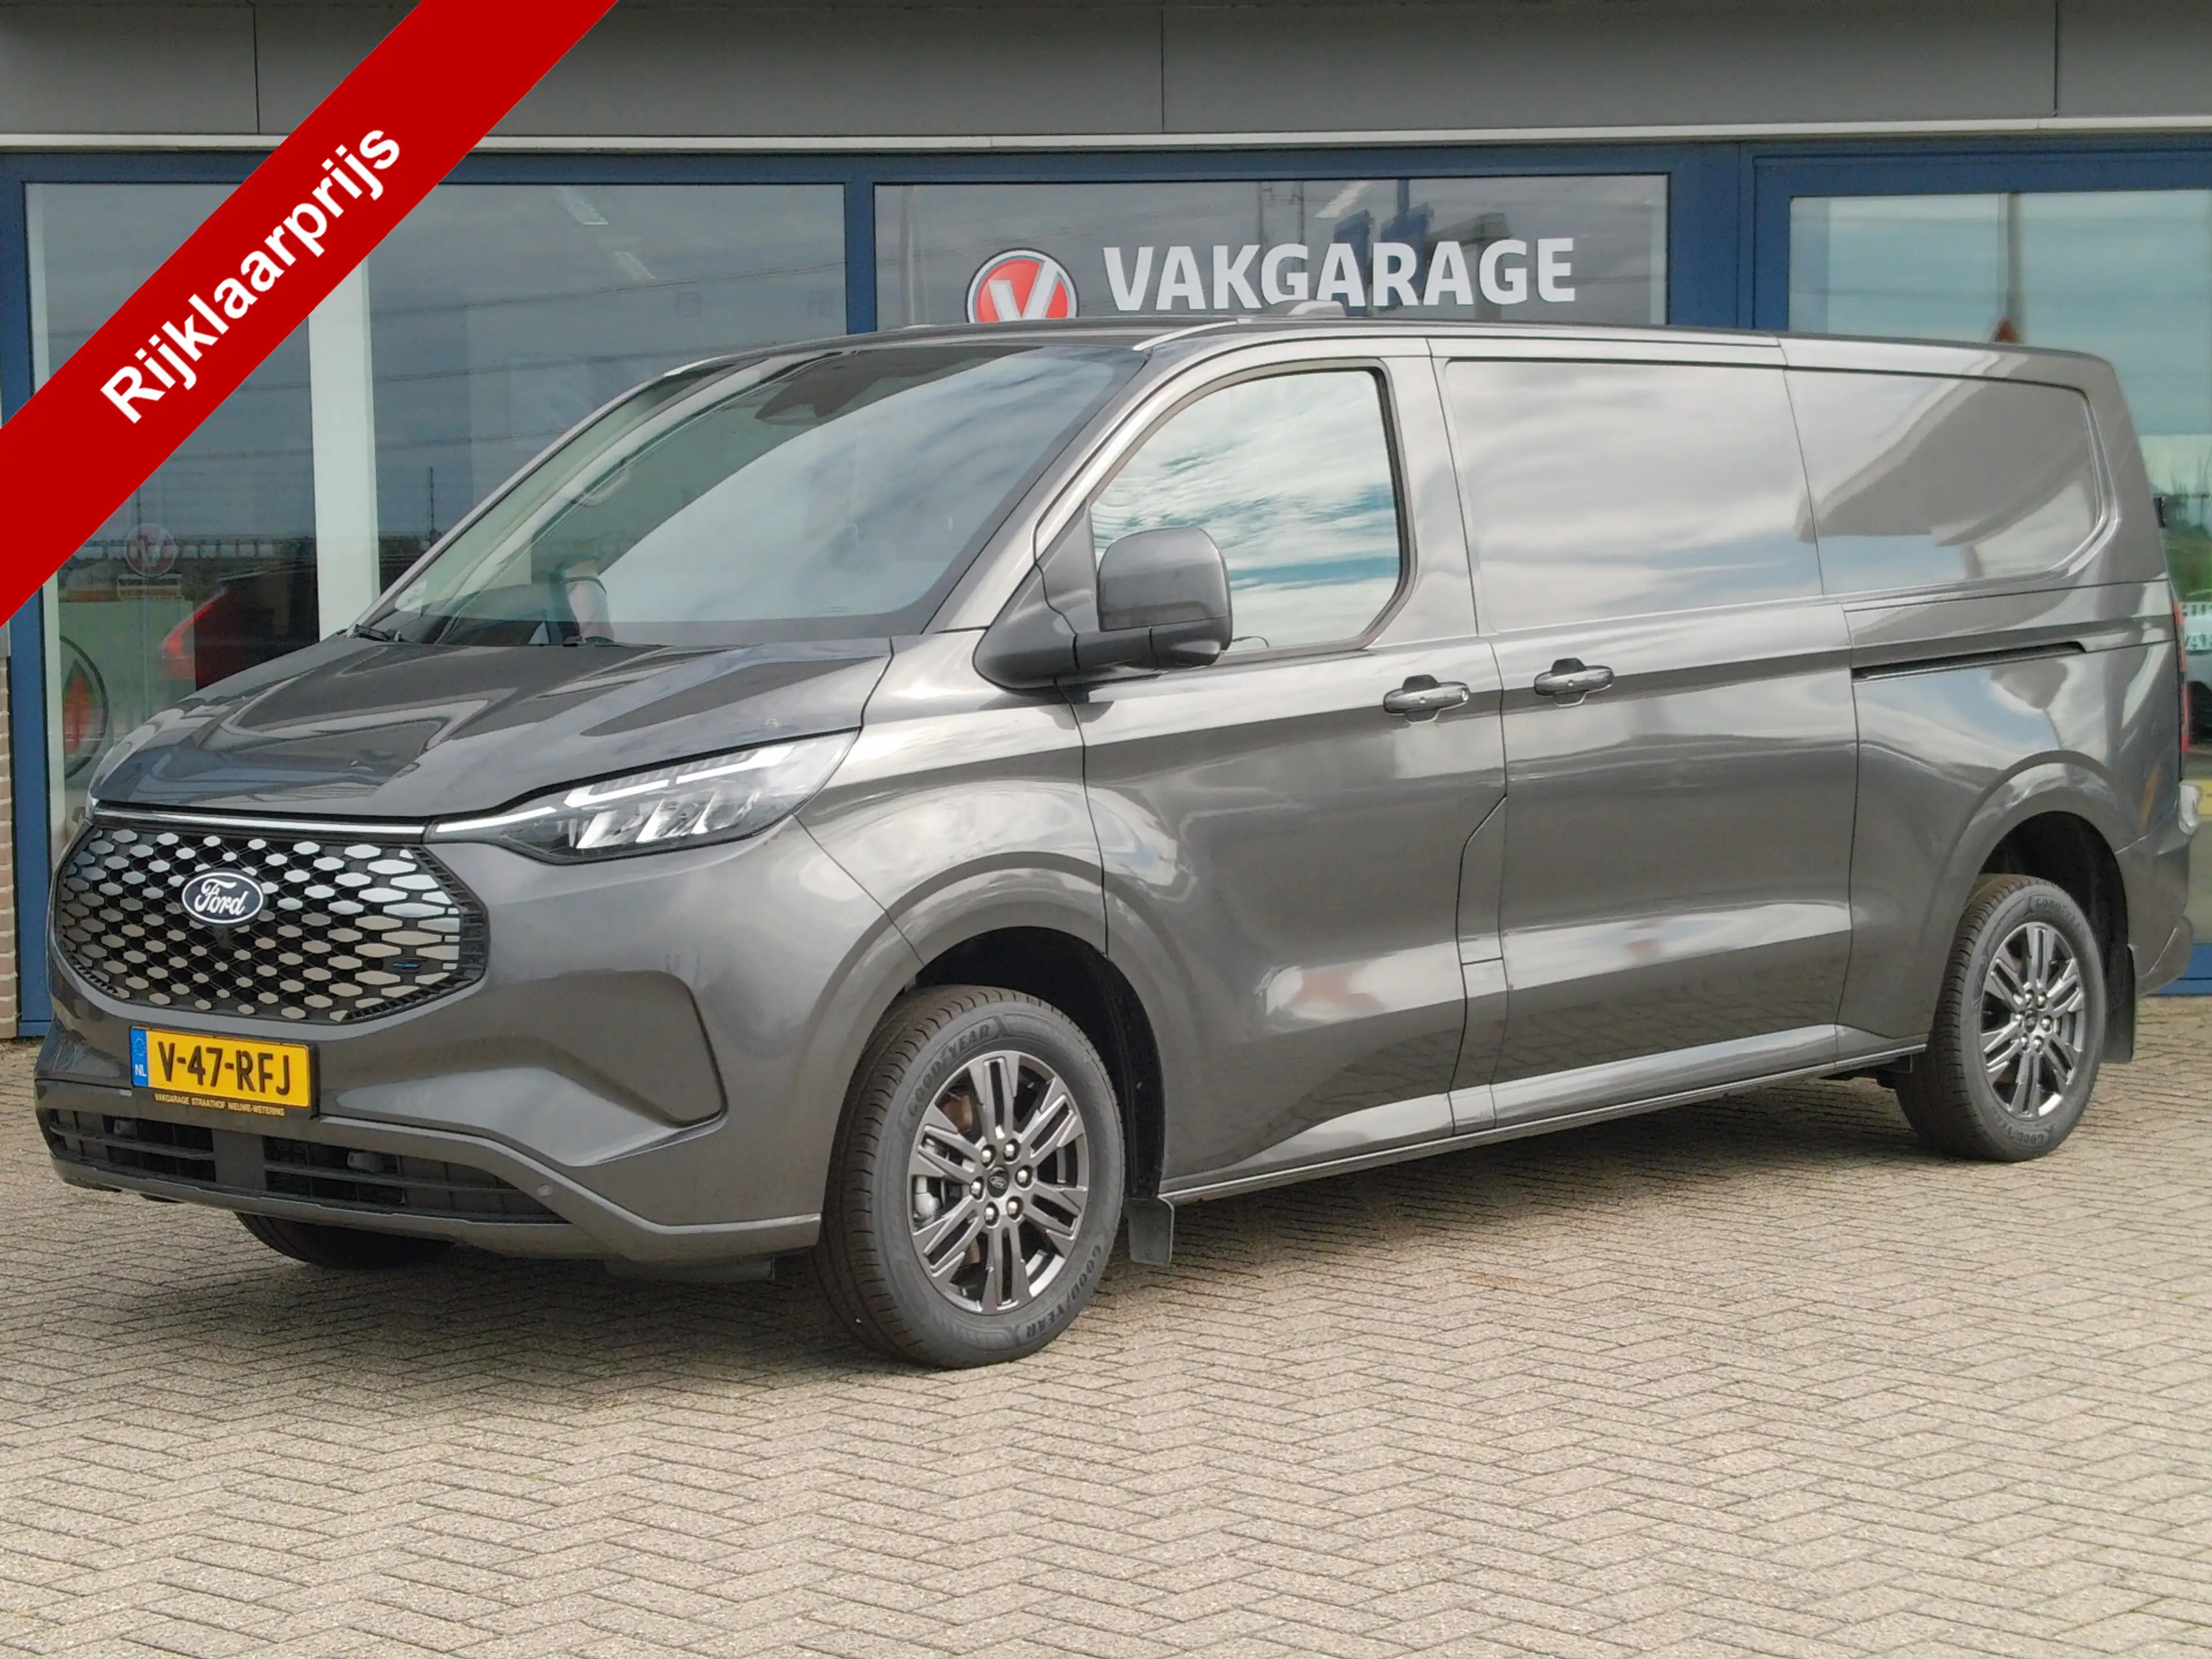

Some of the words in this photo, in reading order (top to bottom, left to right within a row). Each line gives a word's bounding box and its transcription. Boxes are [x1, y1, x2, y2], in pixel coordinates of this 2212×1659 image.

[1103, 238, 1575, 312] VAKGARAGE
[194, 878, 249, 916] Ford
[134, 1063, 147, 1078] NL
[157, 1040, 291, 1096] V-47-RFJ
[907, 1024, 990, 1118] GOODYEAR
[154, 1092, 190, 1105] VAKGARAGE
[191, 1097, 226, 1109] STRAATHOF
[1026, 1245, 1101, 1338] GOODYEAR
